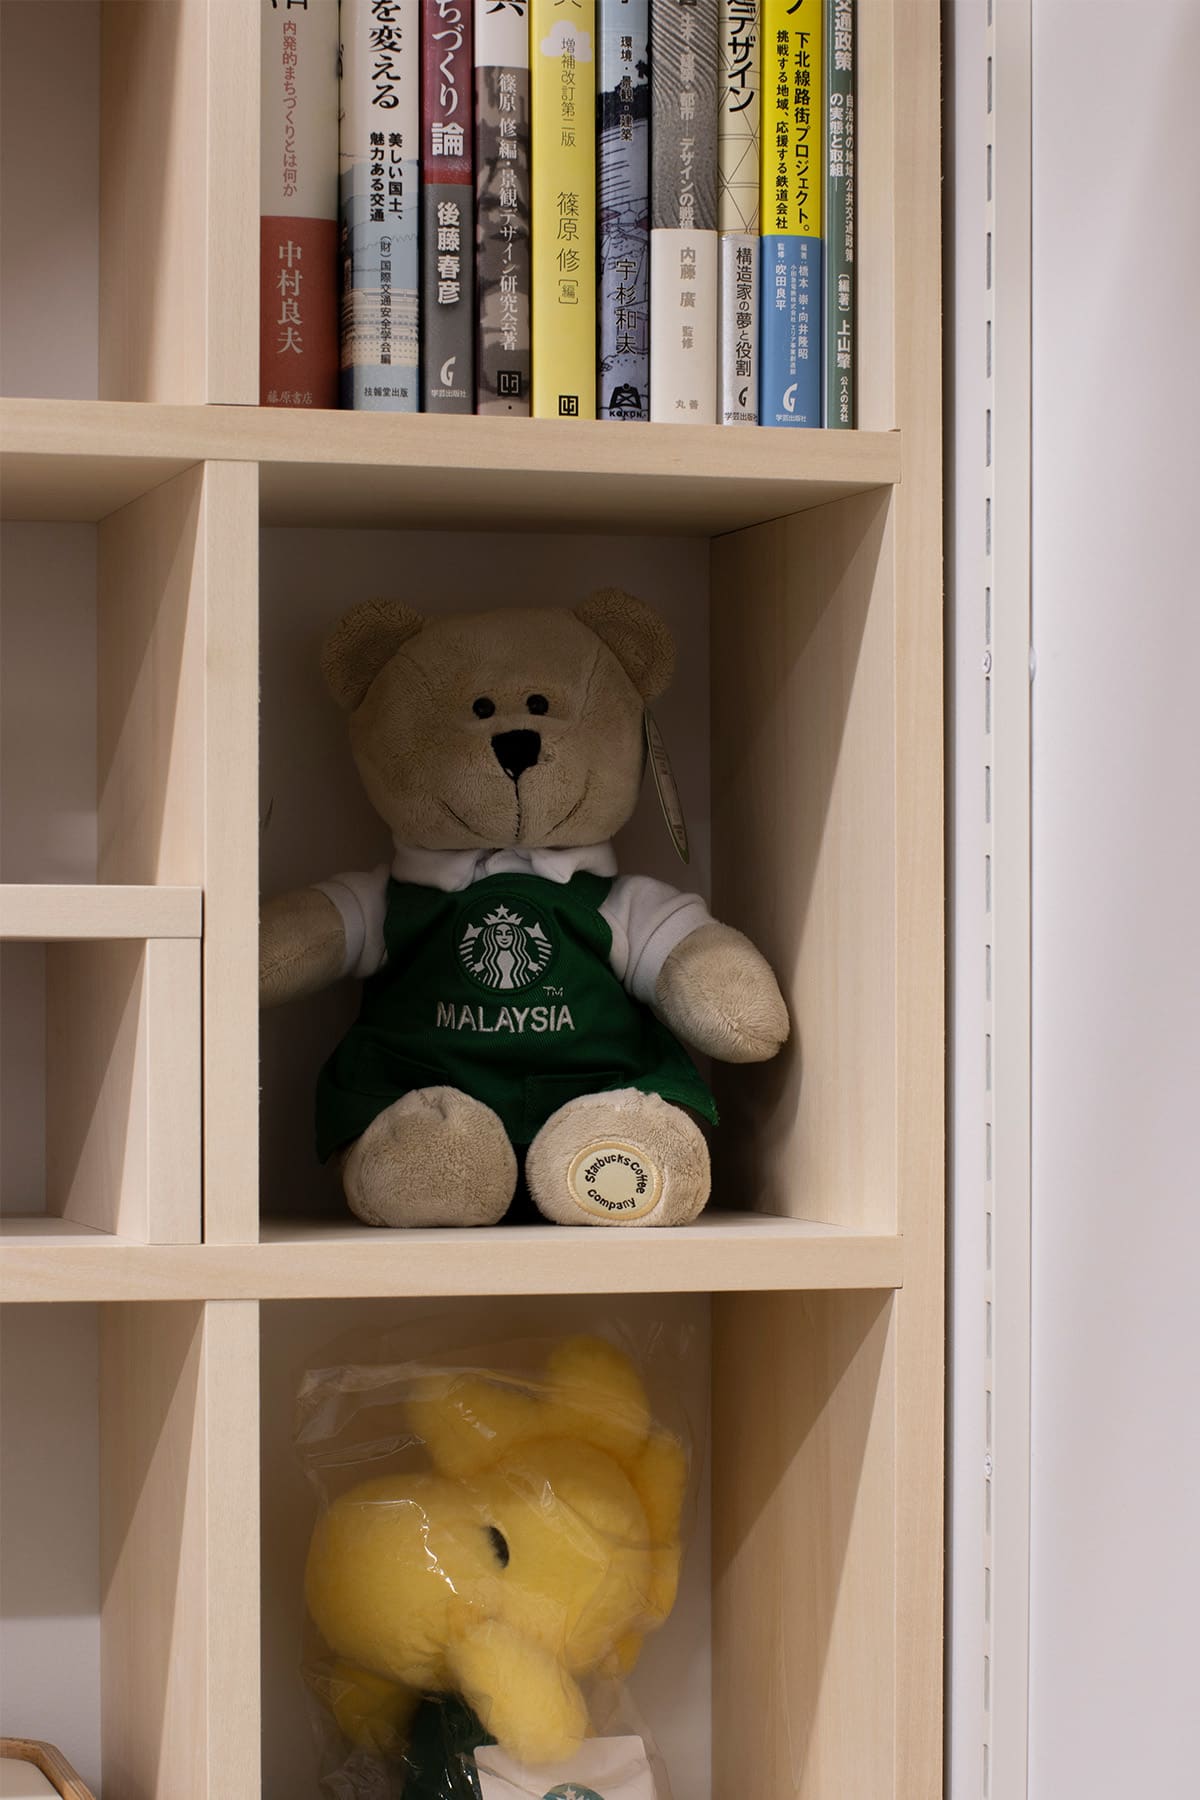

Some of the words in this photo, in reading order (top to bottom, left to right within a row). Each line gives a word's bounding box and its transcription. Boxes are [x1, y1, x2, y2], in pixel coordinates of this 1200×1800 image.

[282, 20, 298, 197] 内発的まちづくりとは何か
[560, 37, 577, 148] 増補改訂第二版
[775, 30, 790, 229] 挑戦する地域、応援する鉄道会社
[794, 32, 811, 232] 下北線路街プロジェクト。
[370, 132, 385, 222] 魅力ある交通
[388, 132, 404, 221] 美しい国土、
[557, 192, 580, 240] 篠原
[437, 201, 461, 305] 後藤春彦
[557, 247, 580, 272] 修
[680, 246, 697, 280] 内藤
[277, 240, 304, 354] 中村良夫
[615, 258, 638, 355] 宇杉和夫
[736, 247, 753, 377] 構造家の夢と役割
[682, 325, 694, 349] 監修
[266, 390, 313, 405] 藤原書店
[675, 399, 699, 411] 丸善
[840, 377, 849, 422] 公人の友社
[543, 986, 564, 996] TM
[436, 1001, 576, 1033] MALAYSIA
[585, 1153, 631, 1183] Starbucks
[630, 1162, 648, 1194] Coffee
[587, 1188, 636, 1211] Company
